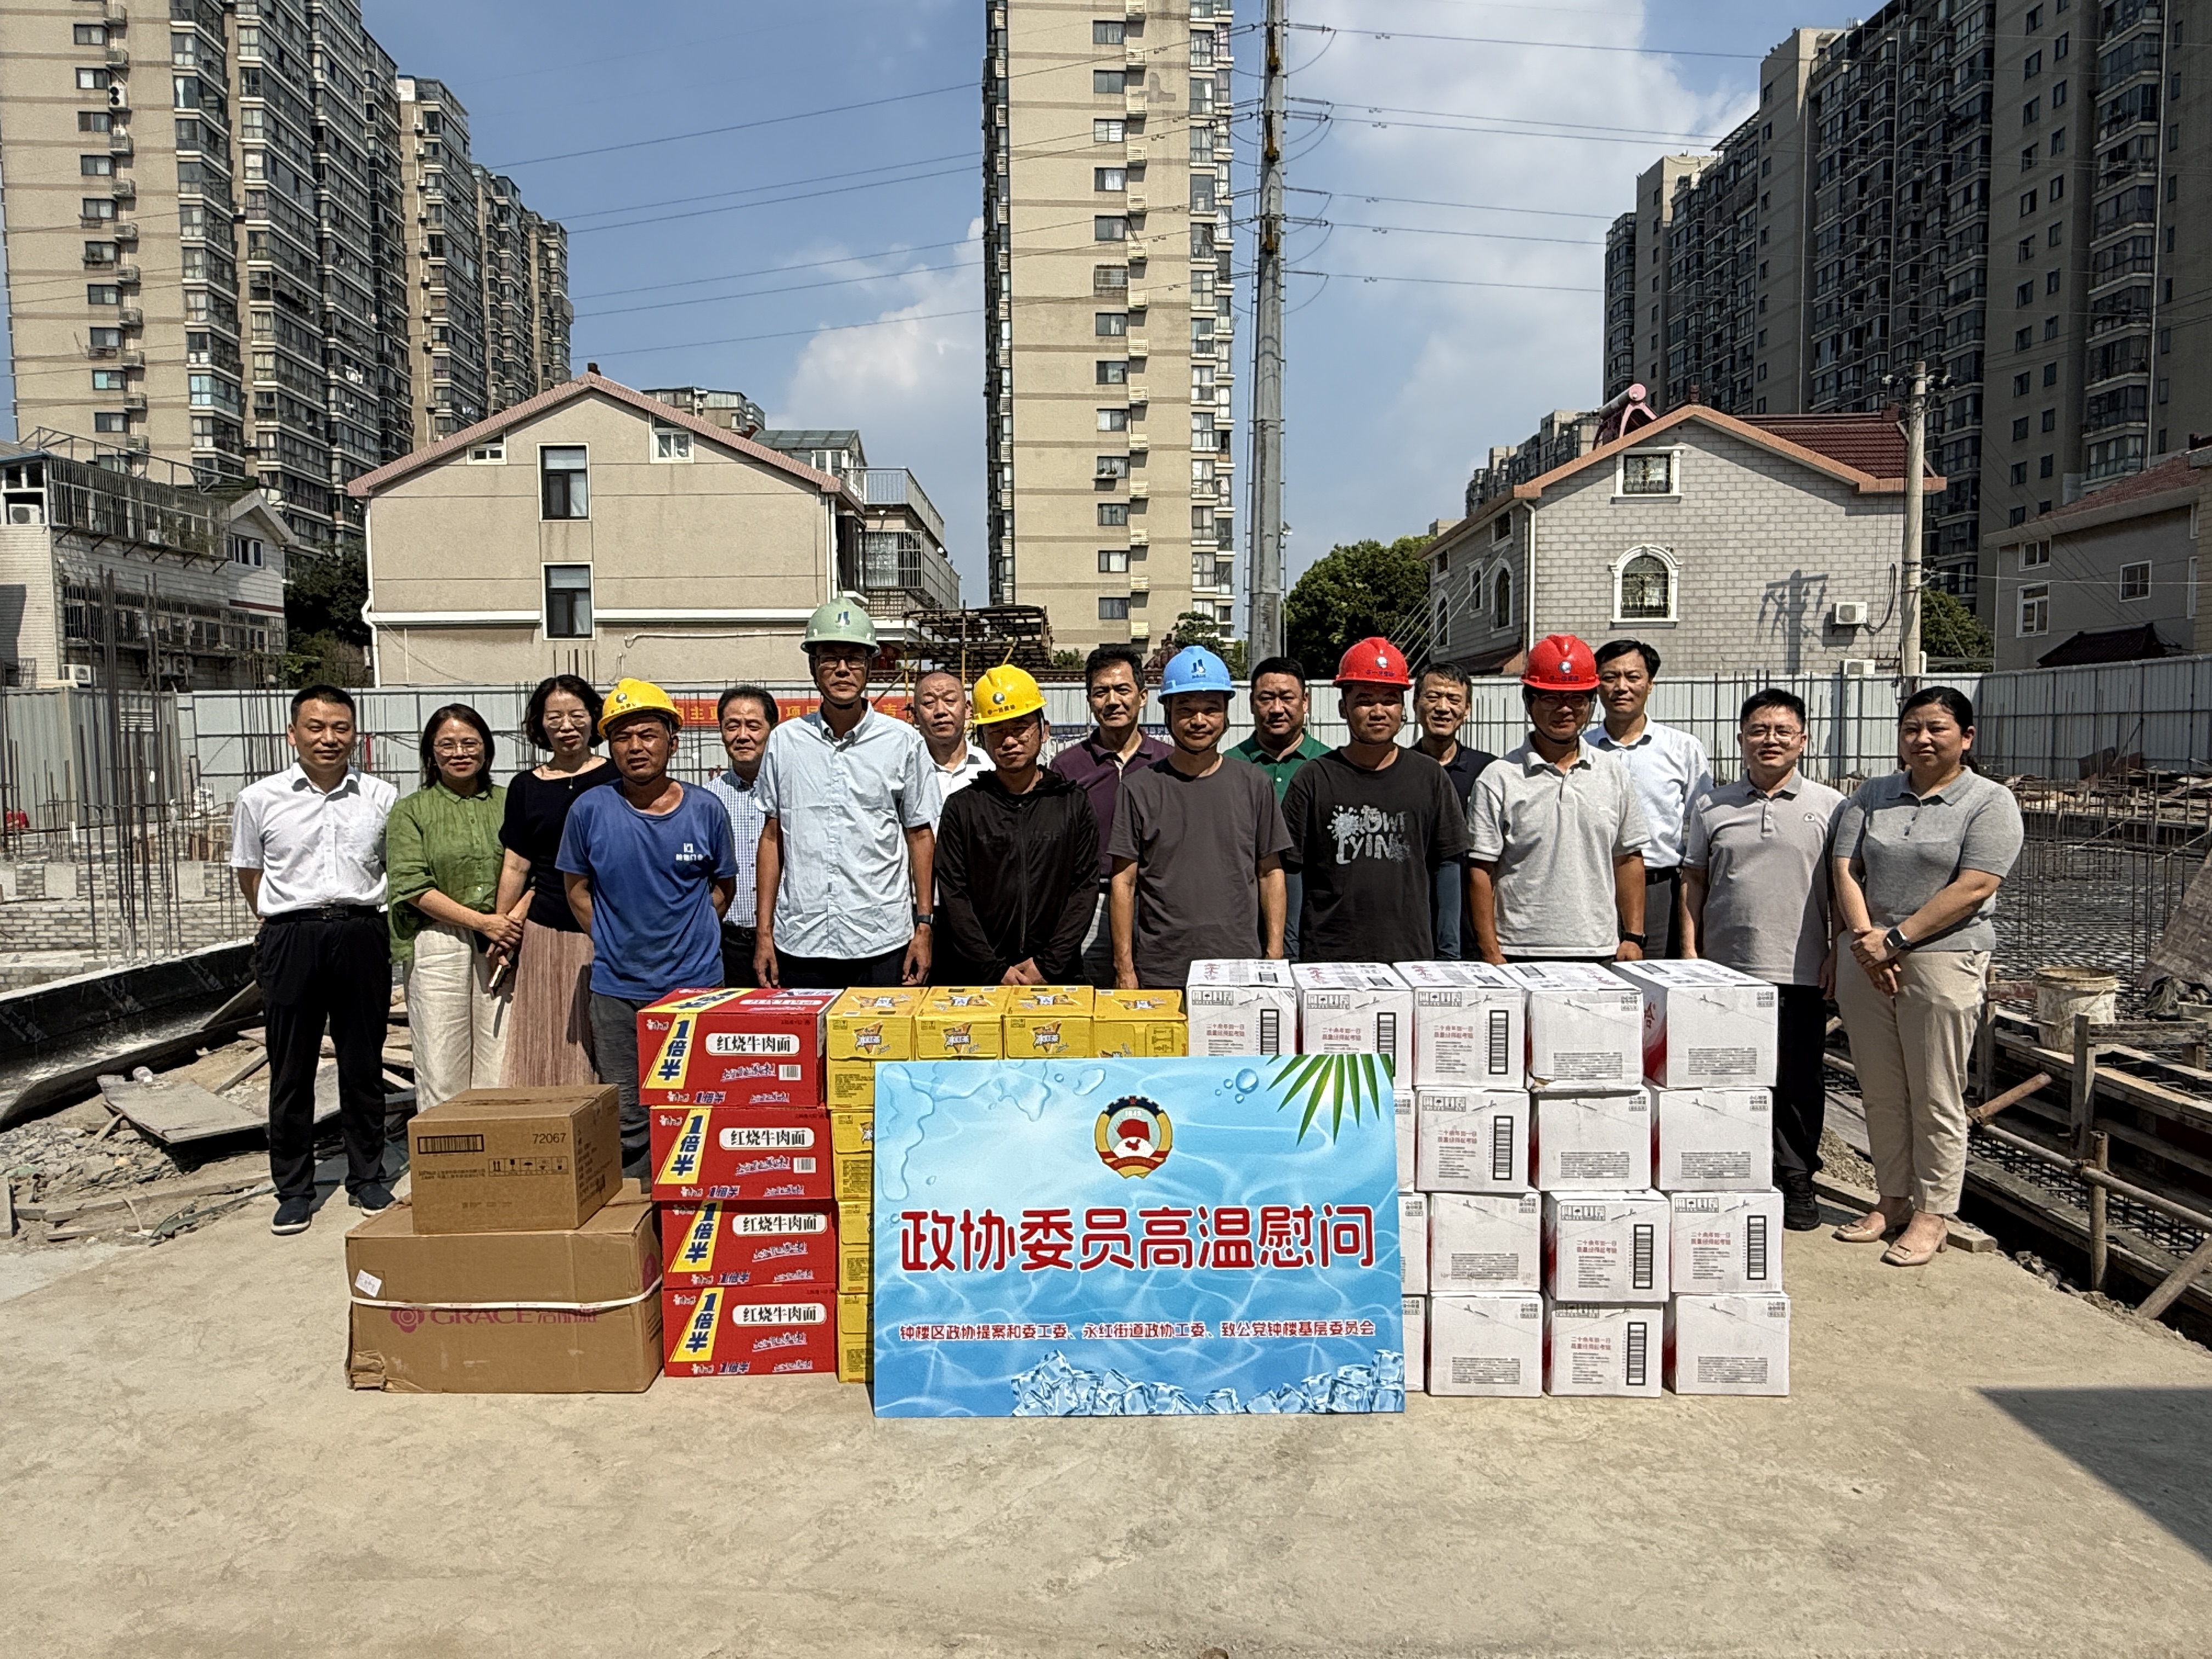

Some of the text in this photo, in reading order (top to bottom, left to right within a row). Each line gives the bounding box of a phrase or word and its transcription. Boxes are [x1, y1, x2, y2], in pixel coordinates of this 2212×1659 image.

[657, 1019, 690, 1081] 1倍半
[716, 1035, 791, 1052] 红烧牛肉面
[532, 1132, 566, 1144] 72067
[670, 1115, 704, 1176] 1倍半
[731, 1129, 806, 1146] 红烧牛肉面
[743, 1215, 817, 1232] 红烧牛肉面
[685, 1203, 717, 1264] 1倍半
[901, 1205, 1374, 1271] 政协委员高温慰问
[430, 1309, 533, 1324] GRACE
[685, 1293, 718, 1353] 1倍半
[743, 1306, 817, 1323] 红烧牛肉面
